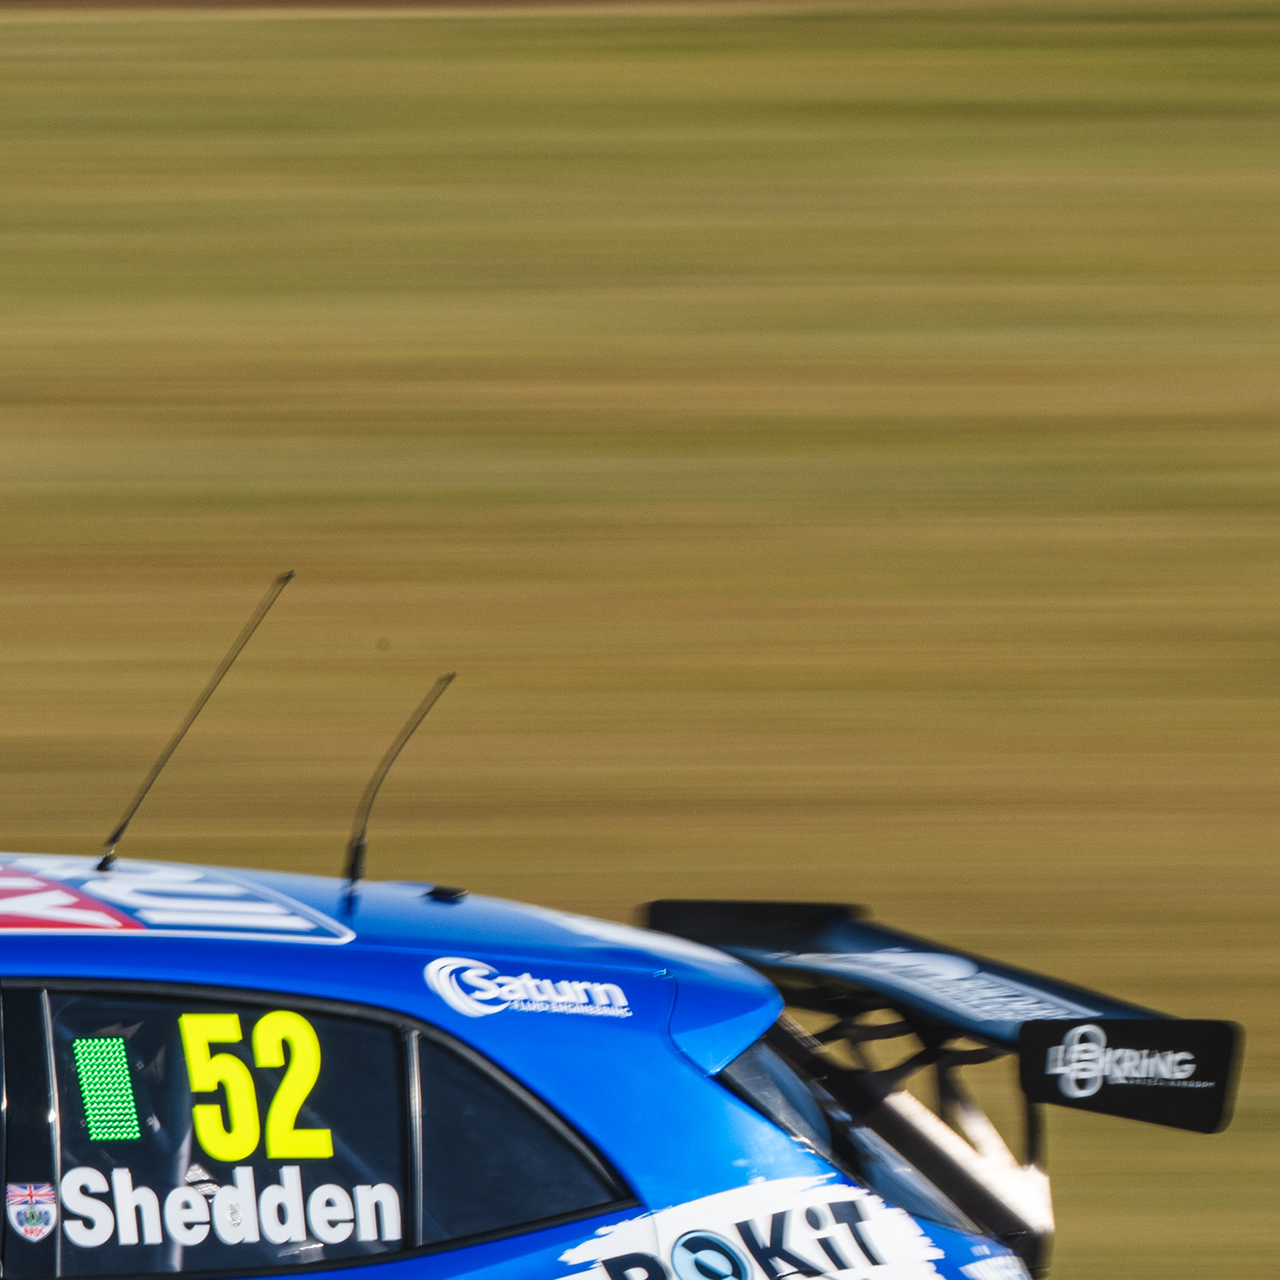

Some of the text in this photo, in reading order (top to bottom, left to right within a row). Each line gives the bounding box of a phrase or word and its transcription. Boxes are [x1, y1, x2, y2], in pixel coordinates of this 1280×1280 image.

[461, 966, 629, 1007] Saturn
[179, 1010, 333, 1161] 52
[61, 1165, 402, 1249] Shedden
